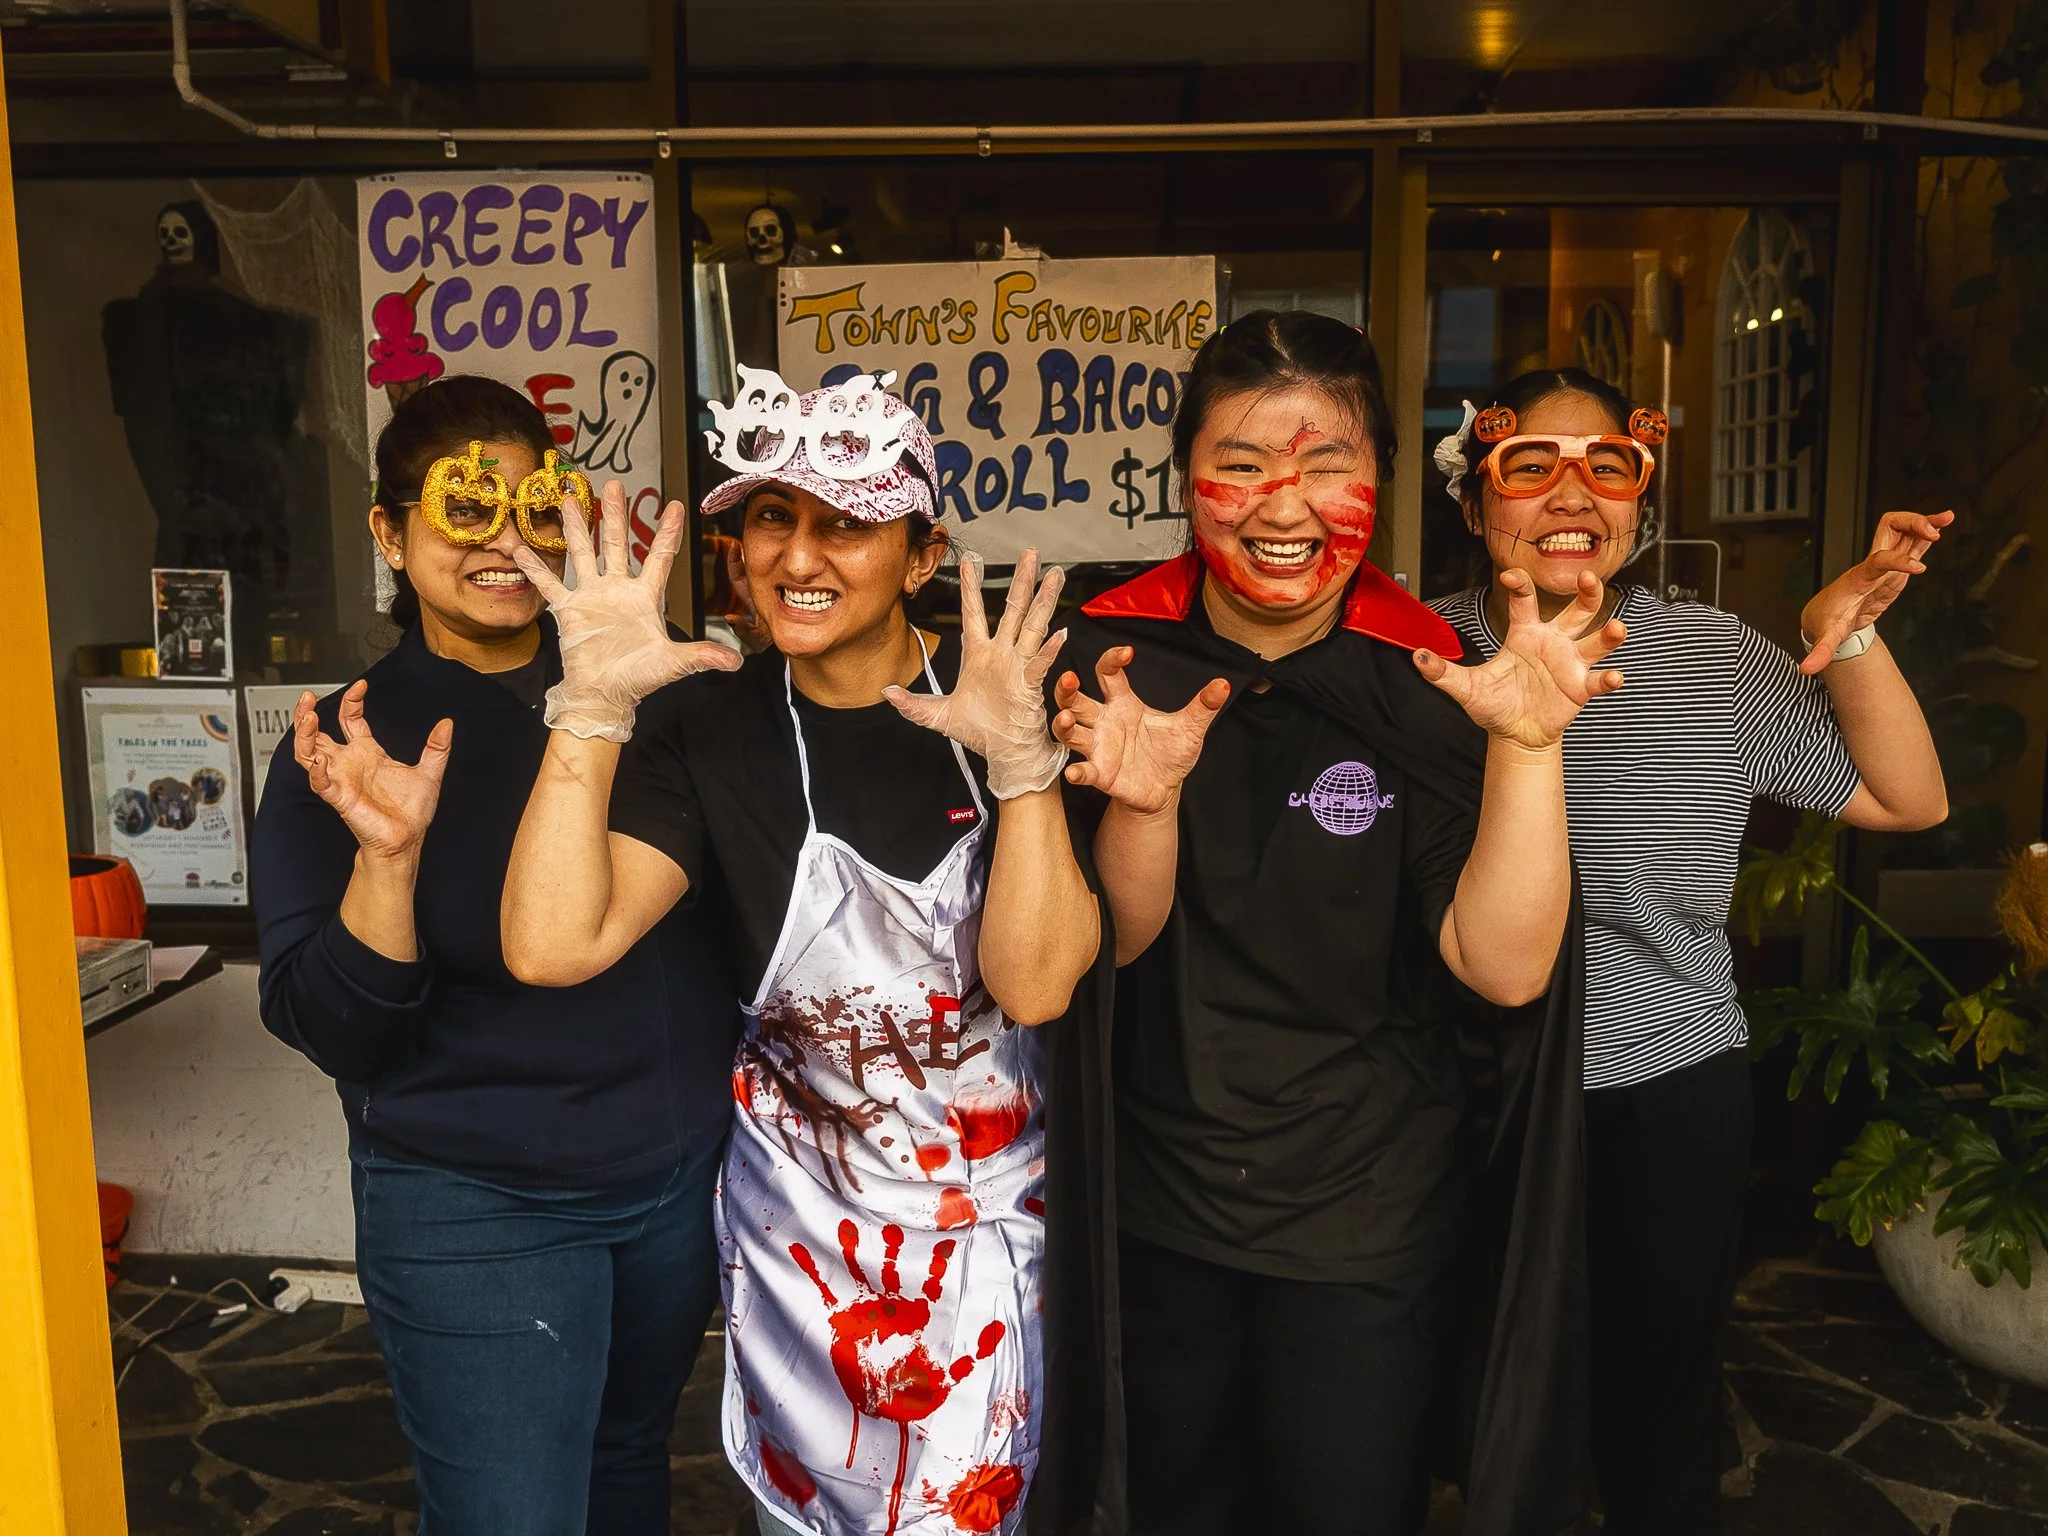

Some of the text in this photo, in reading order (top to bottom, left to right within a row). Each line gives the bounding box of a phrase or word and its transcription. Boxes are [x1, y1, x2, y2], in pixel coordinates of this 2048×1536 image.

[368, 184, 649, 273] CREEPY
[430, 276, 619, 352] COOL
[786, 281, 979, 354] TOWN'S
[967, 351, 1009, 440] &
[1030, 348, 1191, 440] BACO
[933, 437, 1091, 523] ROLL
